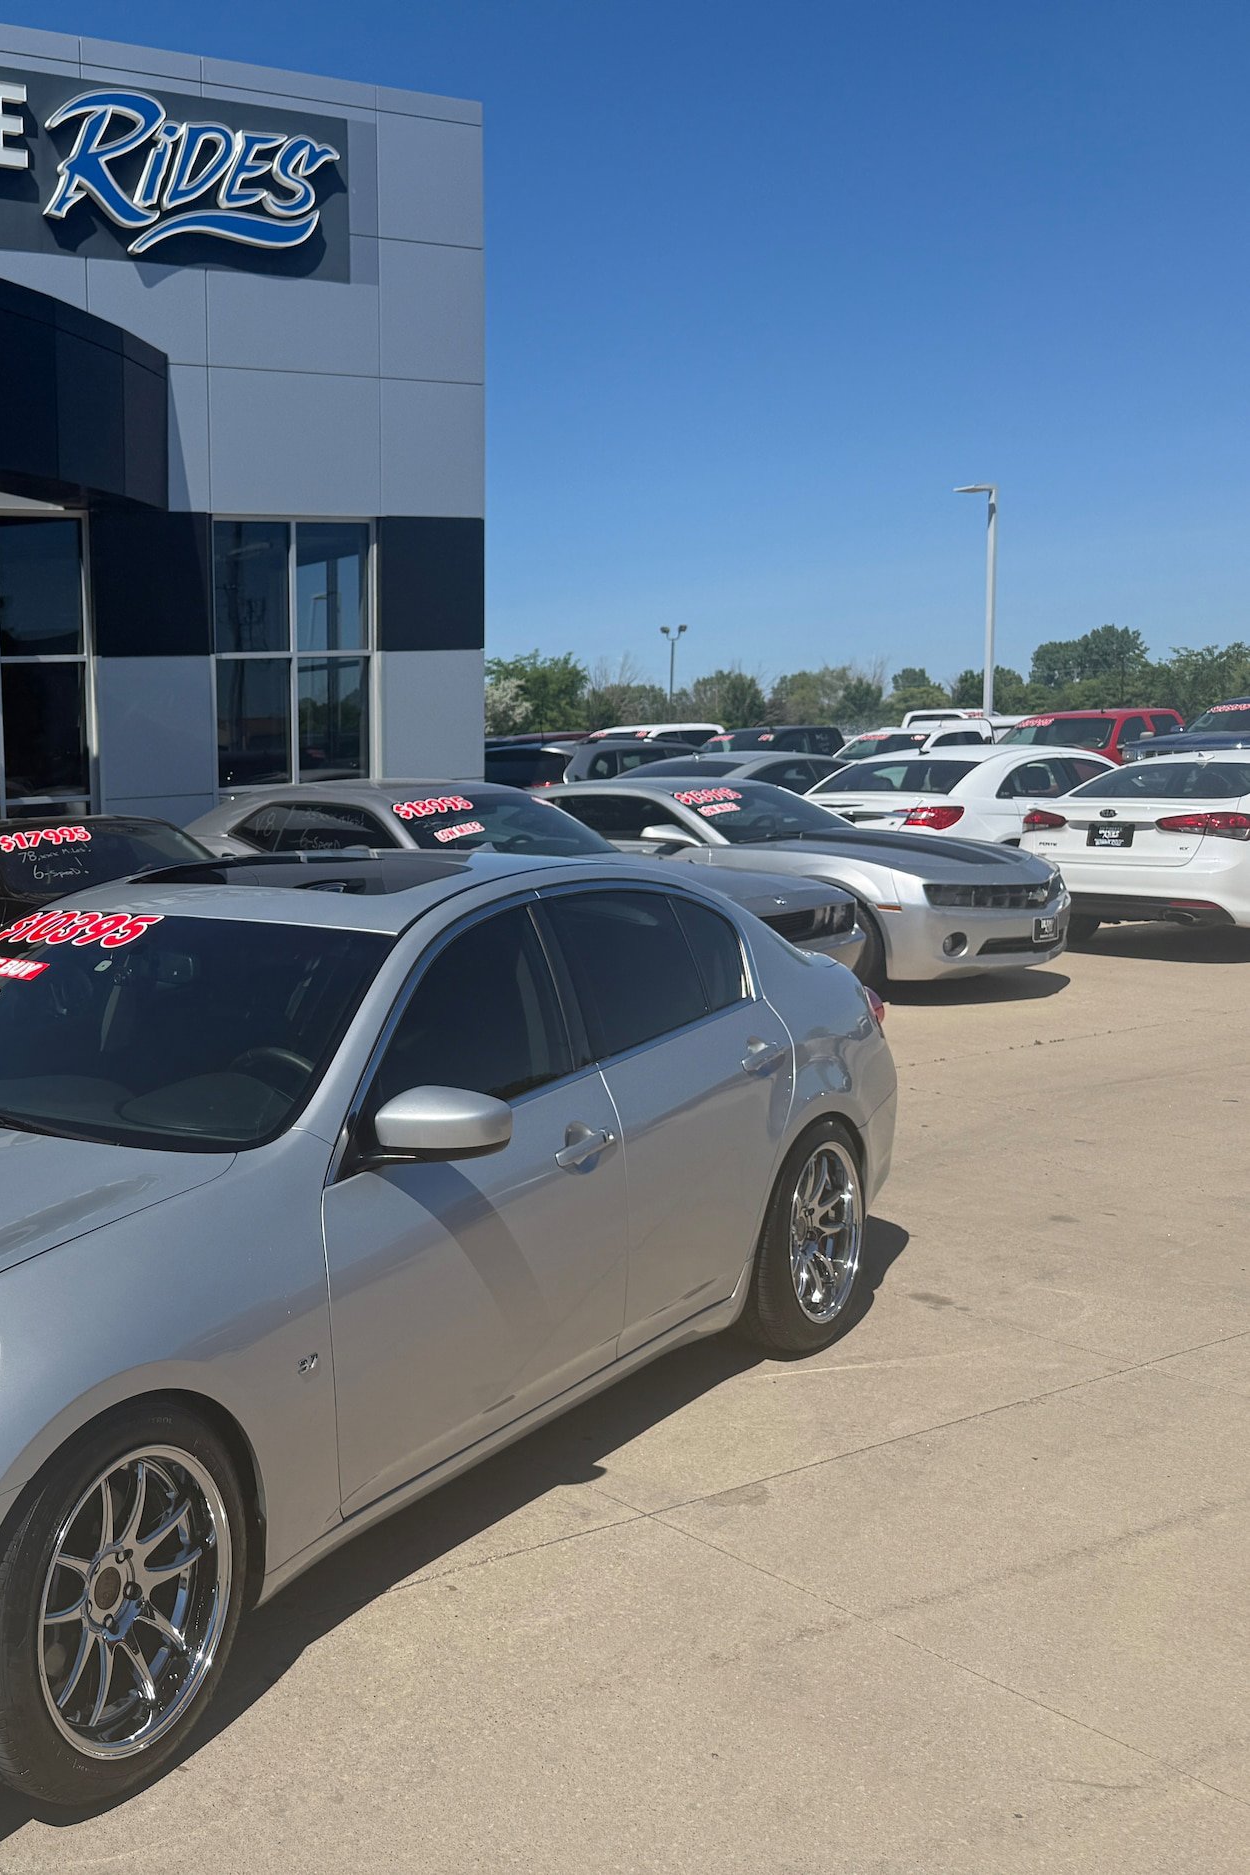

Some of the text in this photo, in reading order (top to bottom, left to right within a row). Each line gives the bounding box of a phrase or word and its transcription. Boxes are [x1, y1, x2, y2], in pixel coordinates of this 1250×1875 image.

[434, 827, 460, 842] LOW
[454, 821, 485, 837] MILES
[0, 960, 44, 978] BUY
